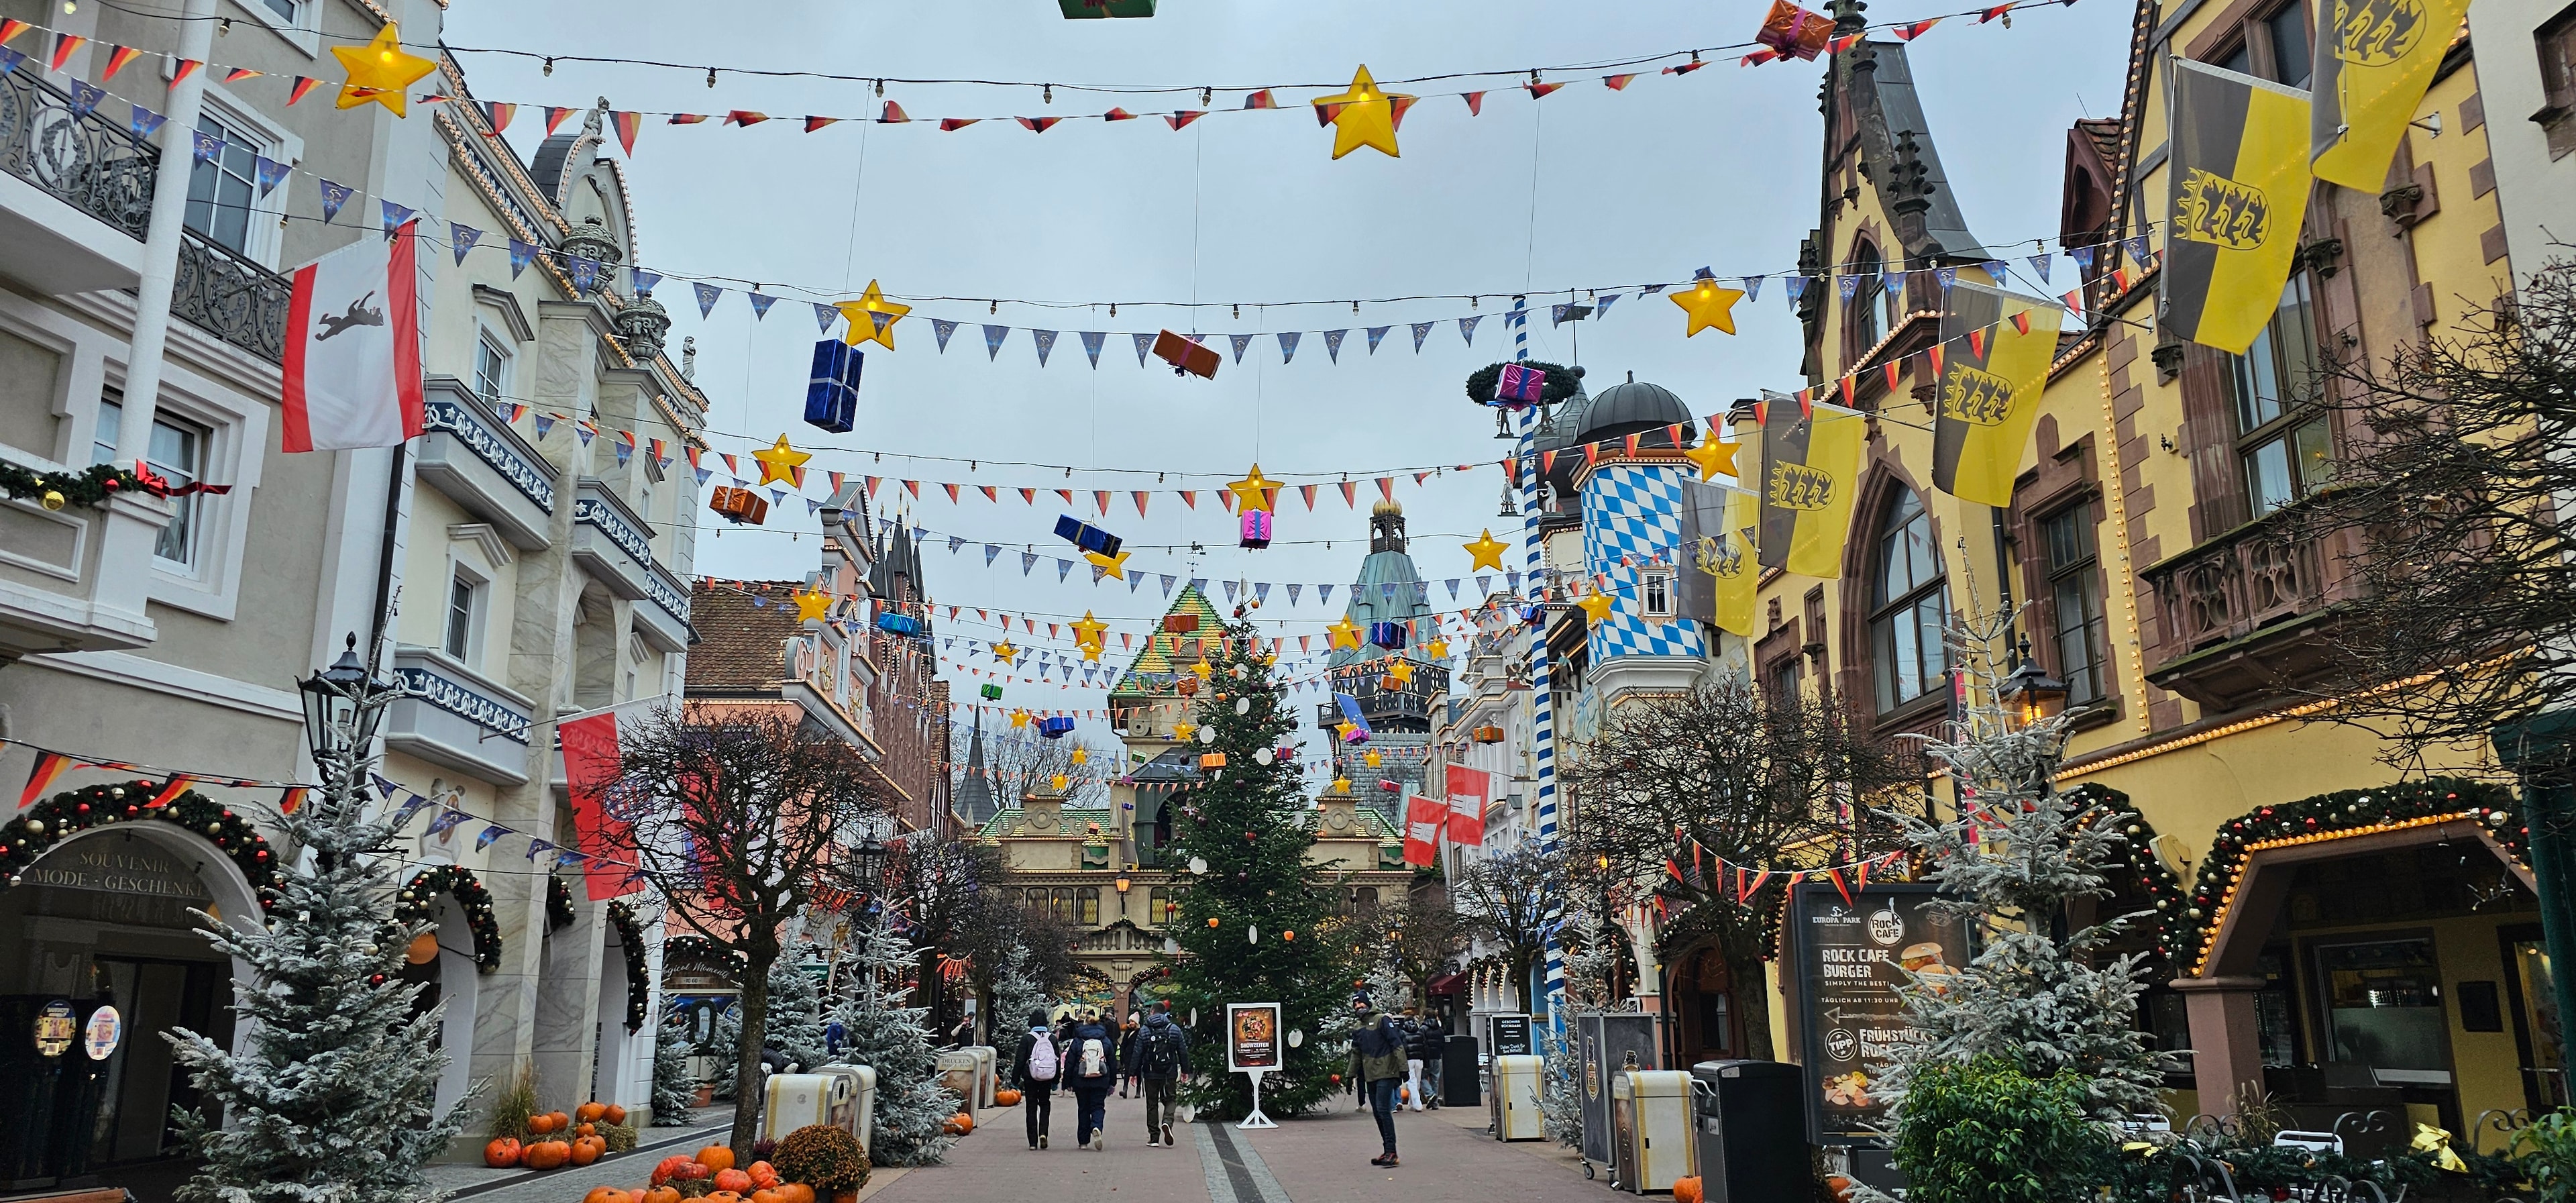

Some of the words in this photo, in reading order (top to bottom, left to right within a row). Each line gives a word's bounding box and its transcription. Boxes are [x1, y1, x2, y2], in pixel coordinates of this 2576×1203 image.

[79, 850, 169, 874] SOUVENIR
[34, 868, 88, 887] MODE
[1872, 913, 1901, 929] ROCK
[1876, 929, 1899, 939] CAFE
[1822, 949, 1856, 962] ROCK
[1858, 949, 1890, 963] CAFE
[1823, 963, 1872, 978] BURGER
[1859, 1026, 1929, 1042] FRÜHSTÜCK
[1828, 1038, 1854, 1051] TIPP
